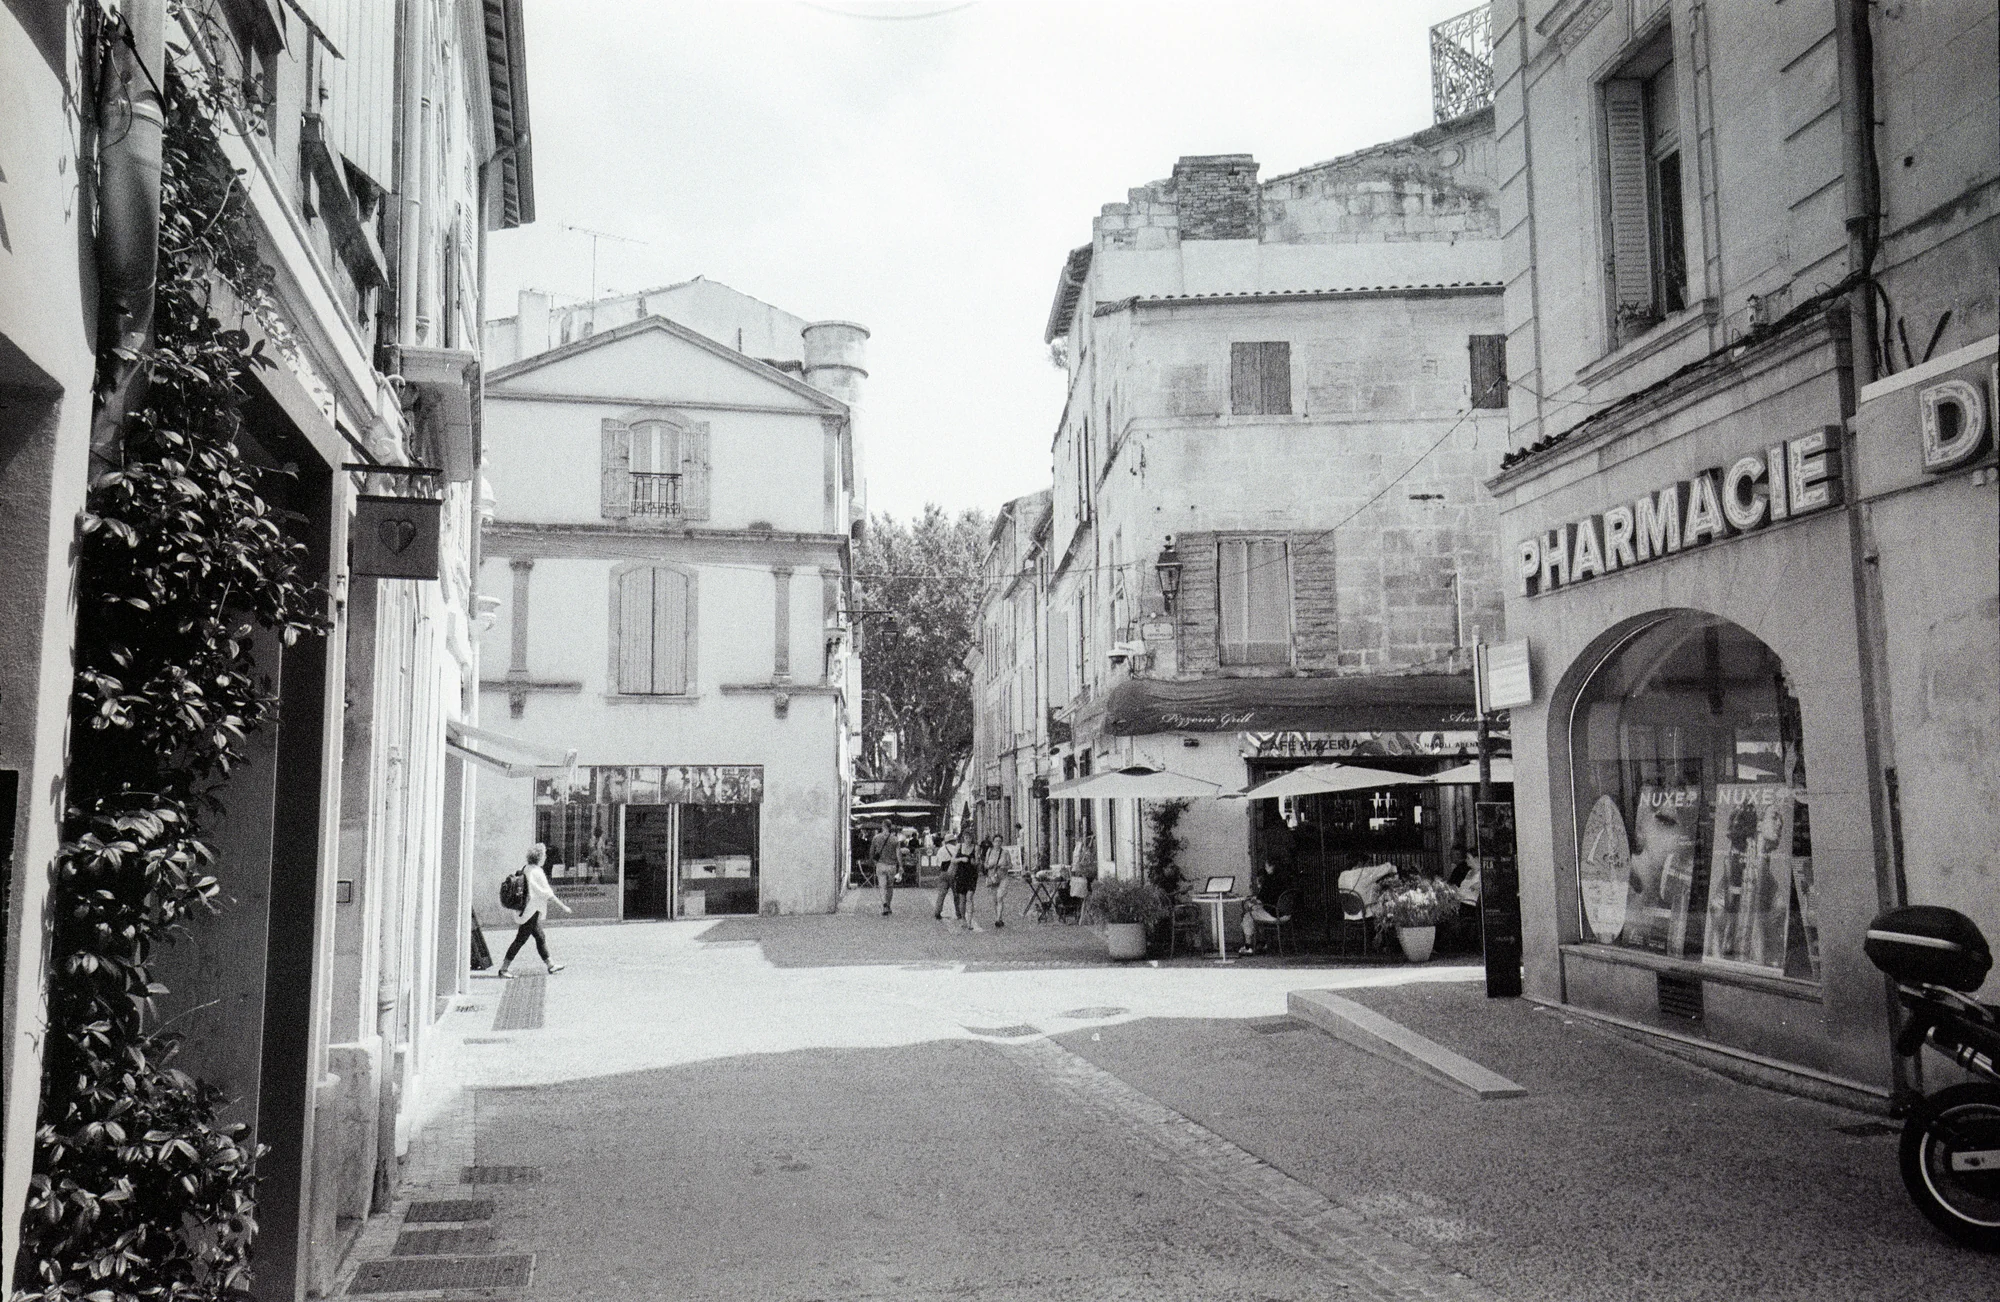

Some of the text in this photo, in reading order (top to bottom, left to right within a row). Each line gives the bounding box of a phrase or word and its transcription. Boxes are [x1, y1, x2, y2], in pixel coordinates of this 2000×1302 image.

[1919, 362, 1998, 474] D
[1517, 427, 1842, 598] PHARMACIE
[1217, 712, 1255, 729] Grill
[1300, 739, 1360, 751] PIZZERIA
[1639, 791, 1684, 807] NUXE
[1718, 788, 1774, 805] NUXE
